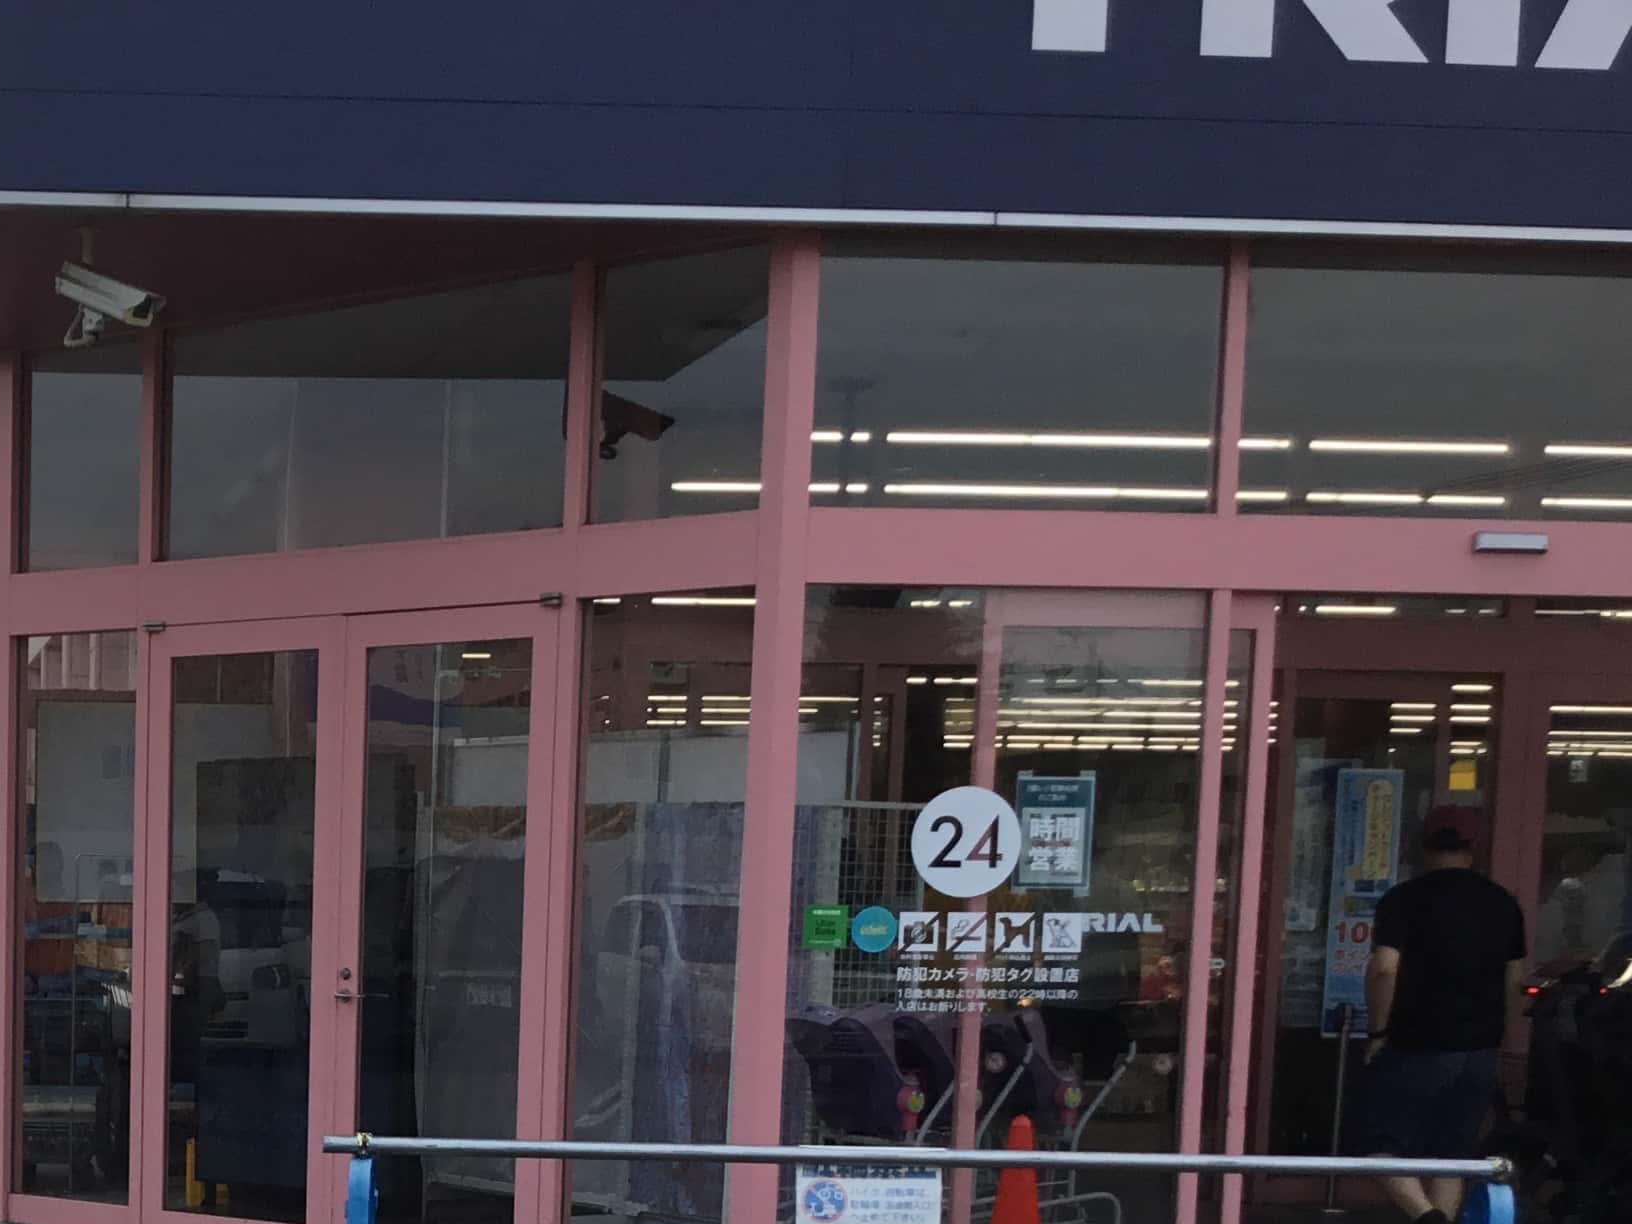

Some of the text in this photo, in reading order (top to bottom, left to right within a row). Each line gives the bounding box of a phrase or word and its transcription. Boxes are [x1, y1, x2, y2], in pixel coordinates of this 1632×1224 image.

[928, 814, 1003, 868] 24
[1029, 816, 1082, 842] 時間
[1027, 846, 1079, 872] 営業
[1081, 912, 1165, 933] RIAL
[1335, 920, 1376, 945] 10
